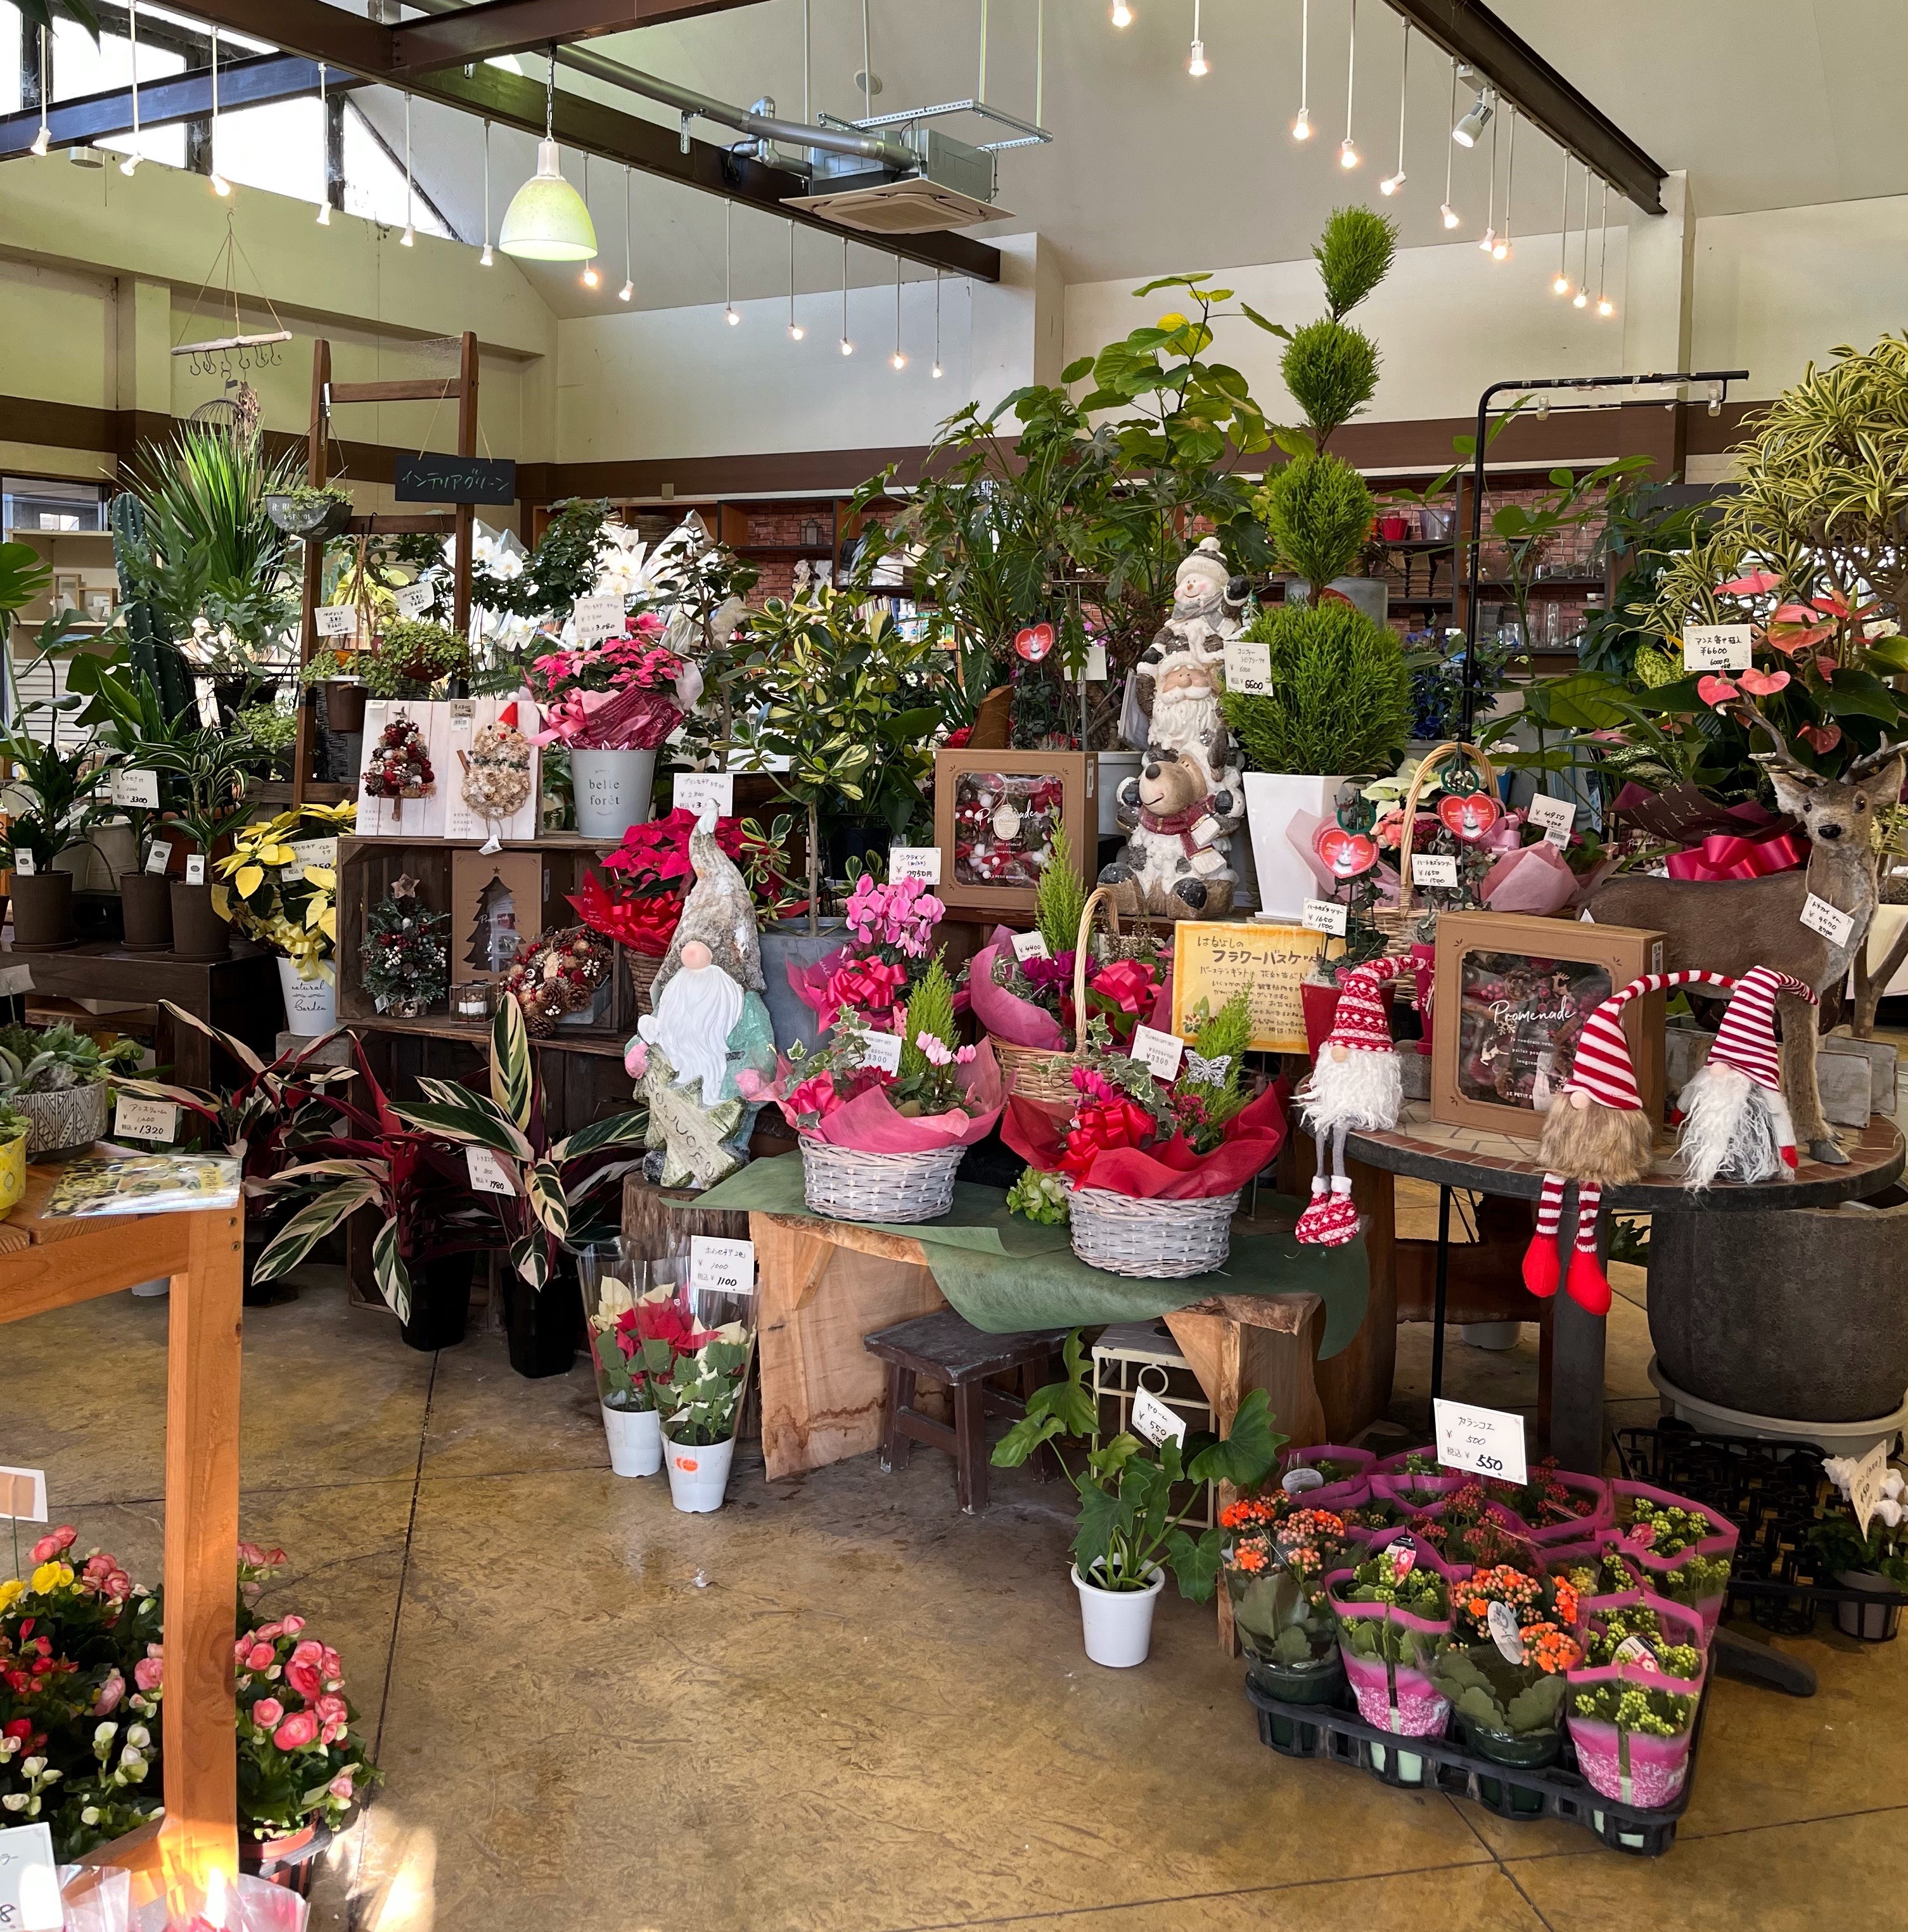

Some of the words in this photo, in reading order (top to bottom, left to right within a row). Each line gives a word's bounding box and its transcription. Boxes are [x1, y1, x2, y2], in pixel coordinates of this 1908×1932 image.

[402, 468, 509, 490] インテリアグリーン
[1701, 647, 1727, 656] ¥6600
[1245, 679, 1263, 689] 6600
[589, 779, 620, 789] belle
[130, 795, 148, 803] 3300
[590, 795, 620, 805] forêt
[1544, 811, 1565, 820] 4950
[1819, 916, 1837, 930] 9570
[1818, 926, 1833, 936] 8700
[291, 979, 325, 990] natural
[293, 999, 327, 1011] Garden
[1489, 995, 1576, 1024] Promenade
[1146, 1052, 1168, 1066] ¥3300
[490, 1180, 504, 1189] 1980
[717, 1277, 738, 1286] 1100
[1149, 1420, 1167, 1436] 550
[1458, 1416, 1495, 1431] カランコエ
[1446, 1429, 1452, 1438] ¥
[1466, 1435, 1486, 1445] 500
[1447, 1447, 1462, 1458] 税込
[1476, 1454, 1503, 1471] 550
